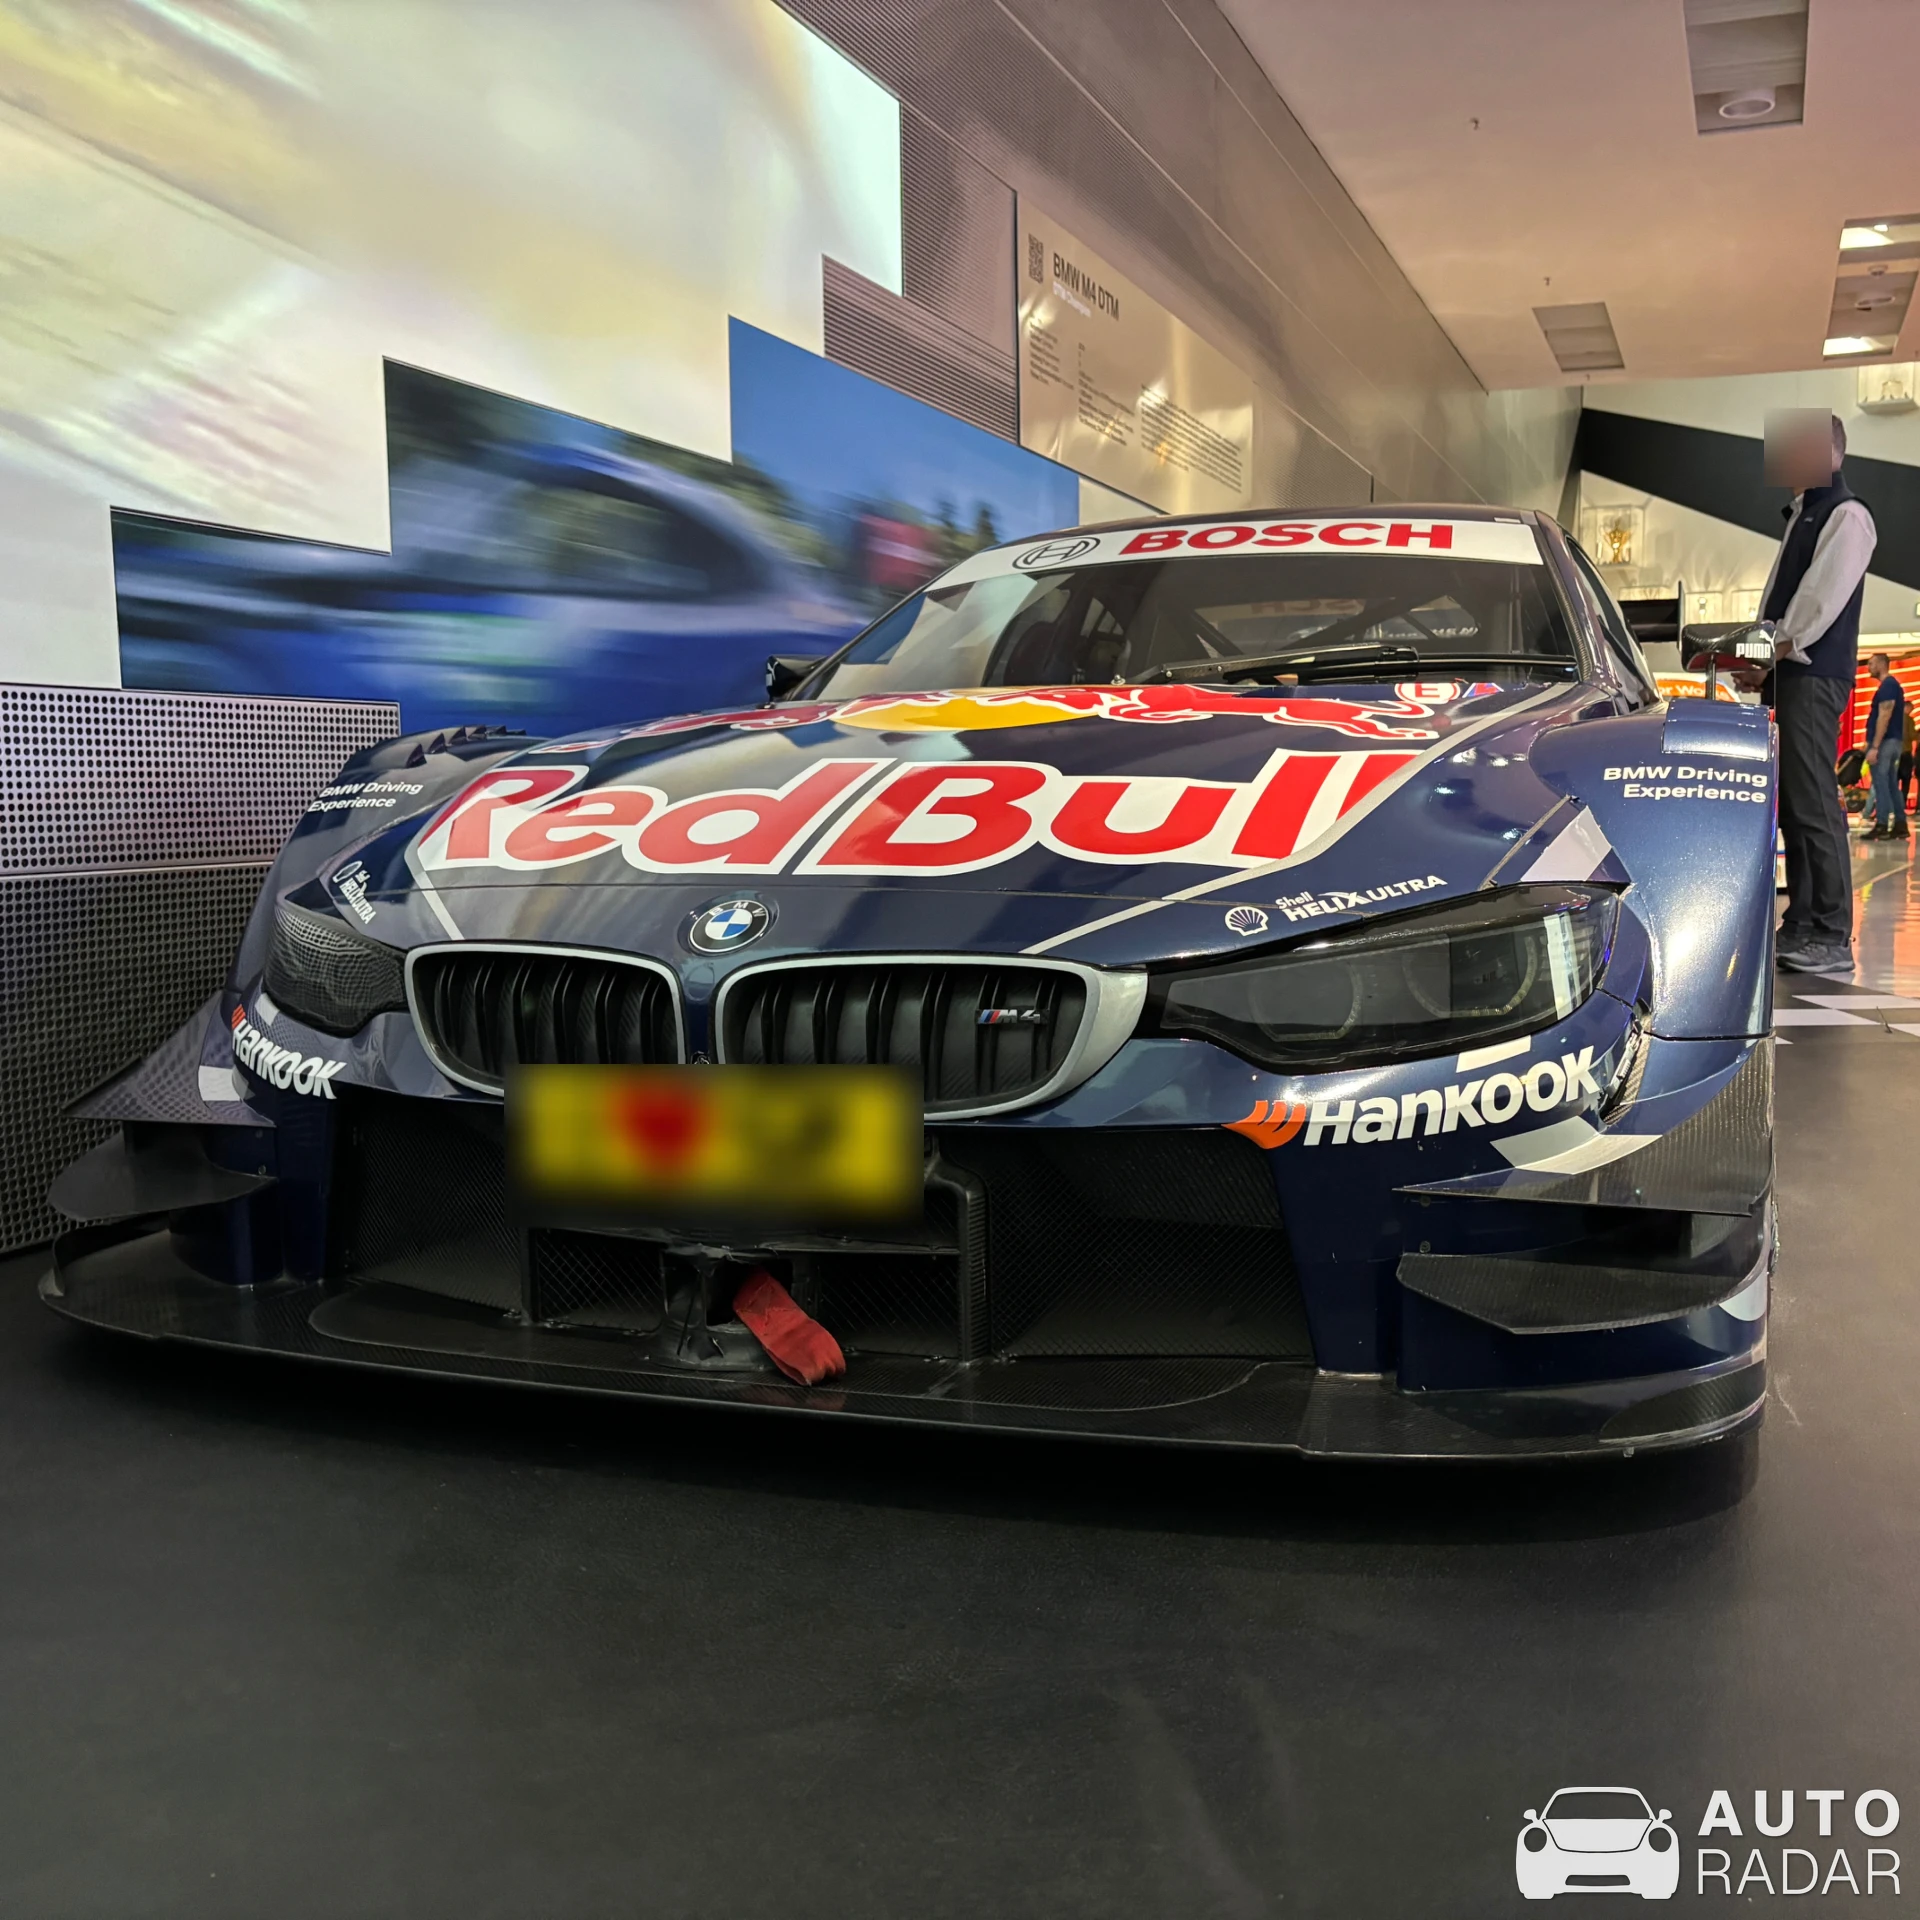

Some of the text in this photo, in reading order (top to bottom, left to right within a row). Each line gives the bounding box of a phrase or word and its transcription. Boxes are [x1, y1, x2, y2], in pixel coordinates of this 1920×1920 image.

[1053, 251, 1081, 292] BMW
[1082, 272, 1097, 305] M4
[1098, 285, 1119, 321] DTM
[1119, 522, 1454, 555] BOSCH
[1735, 643, 1771, 659] PUMA
[1603, 766, 1768, 787] BMW Driving
[320, 781, 423, 797] BMW Driving
[1623, 784, 1767, 803] Experience
[307, 797, 396, 812] Experience
[419, 751, 1418, 867] Red Bull
[708, 901, 766, 917] BMW
[1276, 892, 1314, 909] Shell
